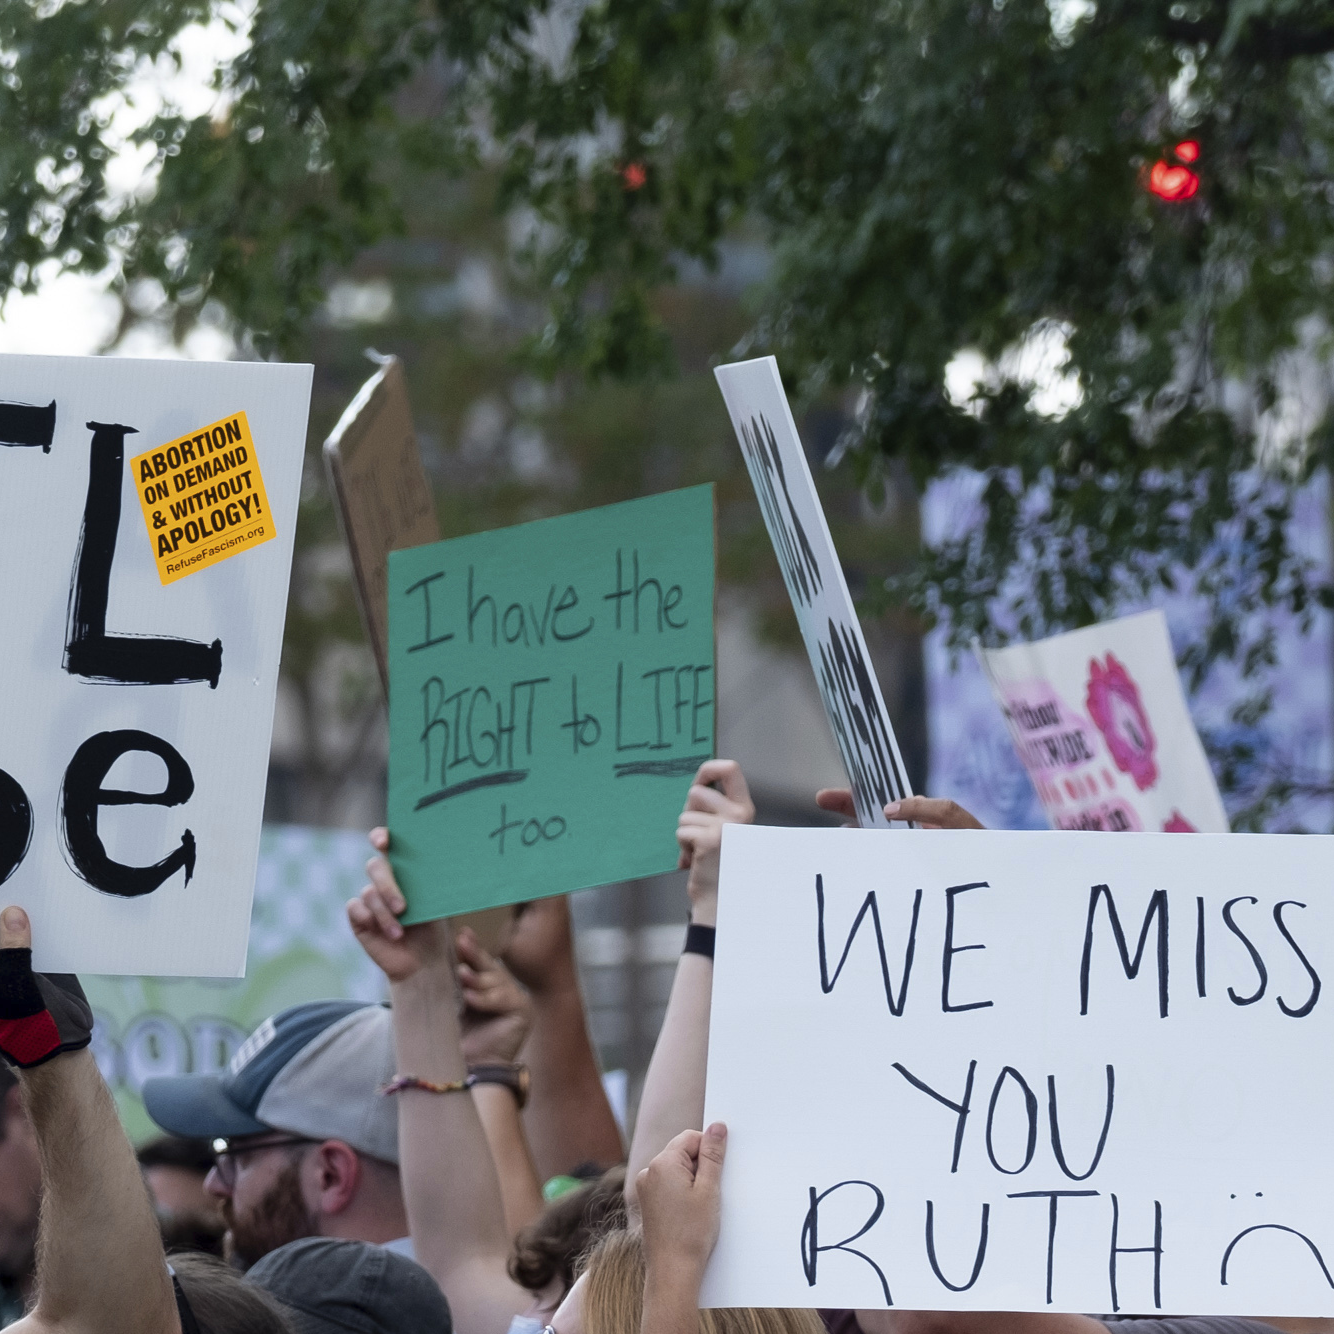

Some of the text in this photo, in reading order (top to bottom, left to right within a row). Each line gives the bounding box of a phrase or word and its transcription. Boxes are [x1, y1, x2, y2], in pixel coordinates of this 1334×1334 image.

[139, 418, 242, 483] ABORTION
[144, 445, 248, 505] ON DEMAND
[152, 469, 253, 530] & WITHOUT
[158, 492, 262, 558] APOLOGY!
[166, 525, 265, 575] RefuseFascism.org
[405, 547, 688, 654] I have the
[420, 660, 713, 786] RIGHT to LIFE
[488, 802, 567, 856] too
[816, 874, 1321, 1018] WE MISS
[892, 1060, 1114, 1180] YOU
[801, 1179, 1164, 1312] RUTH
